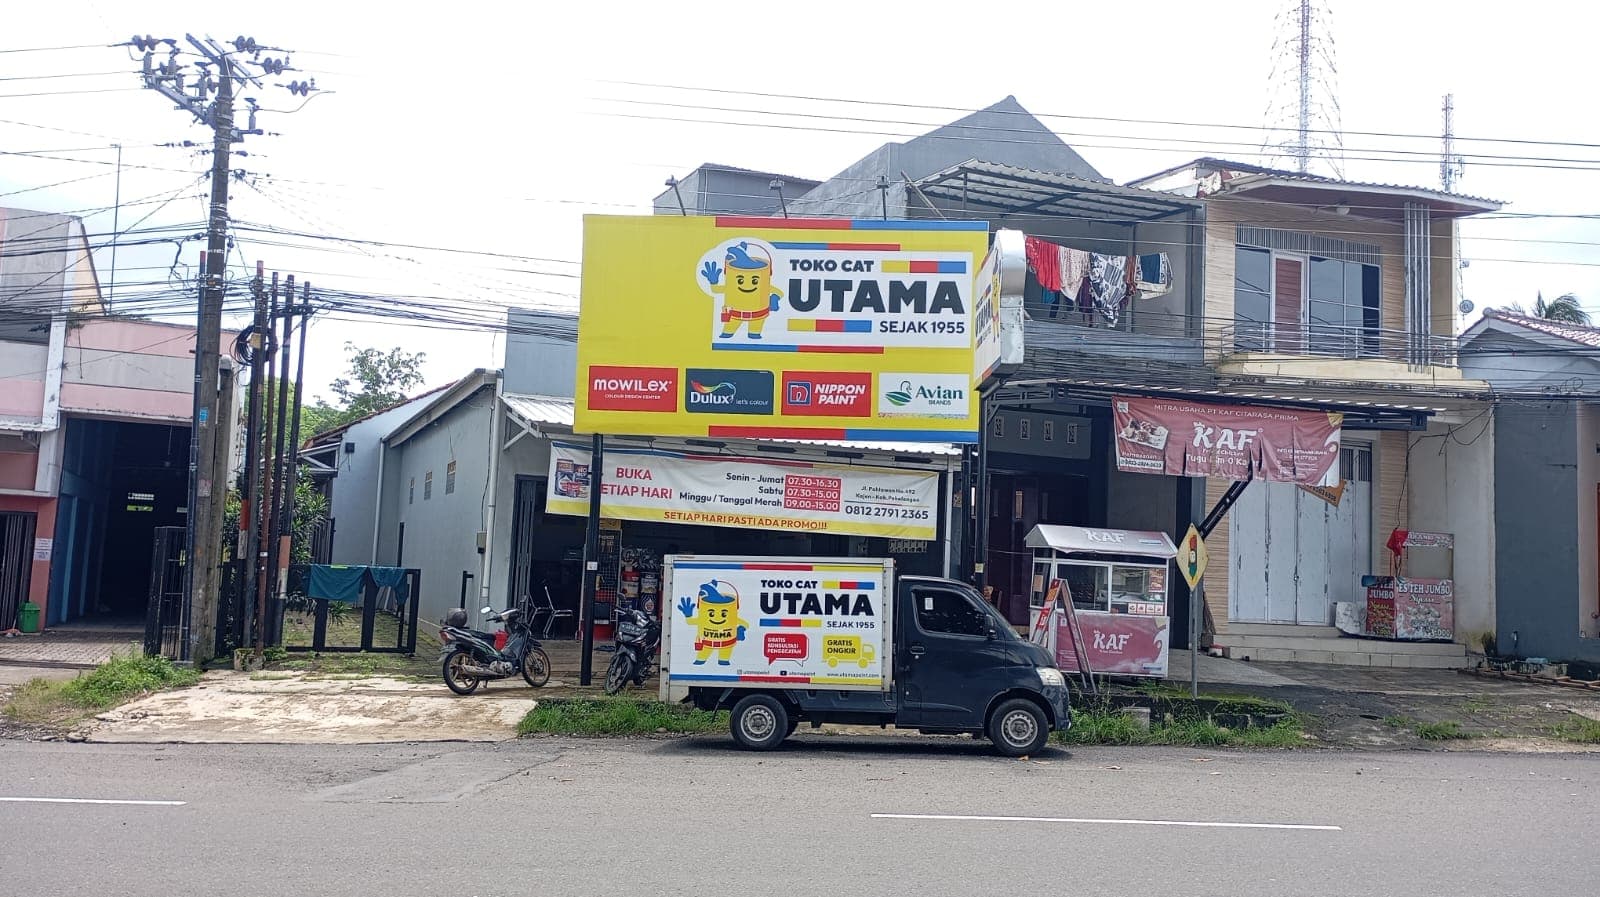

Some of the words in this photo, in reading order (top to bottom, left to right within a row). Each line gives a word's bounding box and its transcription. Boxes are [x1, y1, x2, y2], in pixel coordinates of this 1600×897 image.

[789, 258, 837, 273] TOKO
[841, 260, 875, 273] CAT
[788, 279, 965, 315] UTAMA
[879, 320, 928, 335] SEJAK
[931, 321, 965, 334] 1955
[814, 383, 866, 395] NIPPON
[915, 384, 964, 400] Avian
[690, 391, 730, 405] Dulux
[818, 394, 857, 405] PAINT
[1154, 404, 1178, 412] MITRA
[1179, 406, 1205, 414] USAHA
[1235, 411, 1273, 420] CITARASA
[1275, 414, 1299, 422] PRIMA
[1192, 424, 1258, 450] KAF
[1186, 454, 1207, 464] Tugu
[616, 467, 653, 481] BUKA
[726, 472, 750, 482] Senin
[757, 475, 785, 485] Jumat
[787, 477, 839, 488] 07.30-16.30
[600, 484, 639, 497] ETIAP
[641, 487, 673, 499] HARI
[758, 486, 784, 495] Sabtu
[787, 488, 839, 499] 07.30-15.00
[679, 491, 712, 504] Minggu
[718, 494, 754, 506] Tanggal
[754, 496, 783, 507] Merah
[785, 499, 839, 511] 09.00-15.00
[845, 505, 873, 517] 0812
[875, 507, 900, 518] 2791
[901, 509, 929, 520] 2365
[663, 511, 700, 521] SETIAP
[701, 513, 727, 523] HARI
[727, 515, 756, 525] PASTI
[758, 517, 780, 527] ADA
[780, 518, 827, 530] PROMO!!!
[1085, 529, 1125, 544] KAF
[760, 579, 793, 589] TOKO
[795, 580, 818, 589] CAT
[1398, 583, 1408, 593] ES
[1410, 584, 1424, 594] TEH
[1425, 584, 1450, 595] JUMBO
[1369, 590, 1394, 599] JUMBO
[759, 592, 875, 616] UTAMA
[826, 620, 854, 629] SEJAK
[856, 621, 875, 629] 1955
[703, 631, 732, 639] UTAMA
[1093, 632, 1130, 650] KAF
